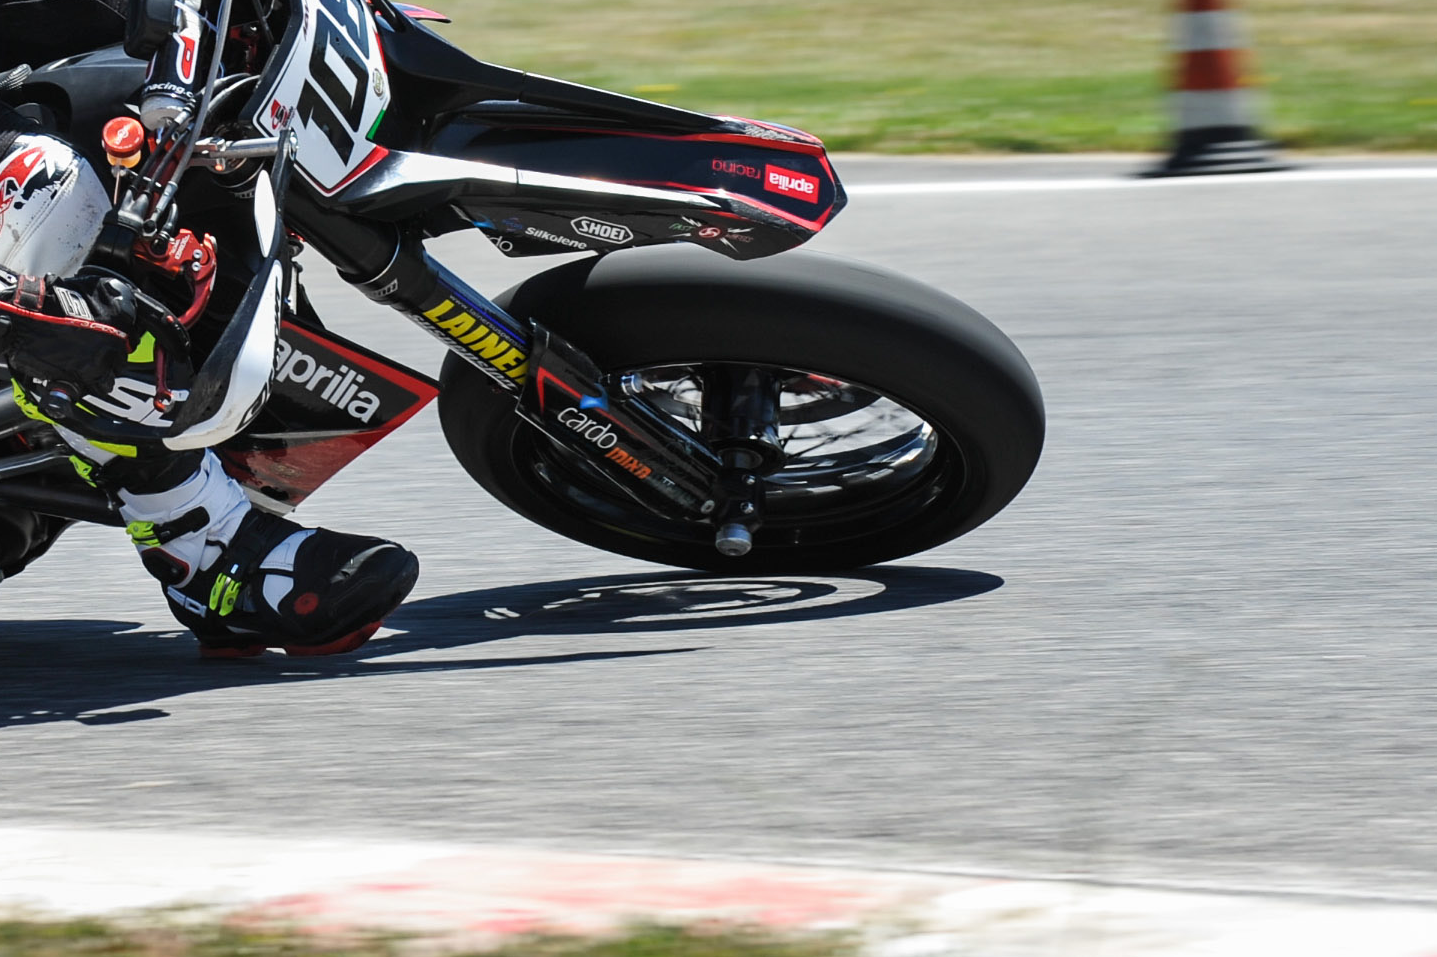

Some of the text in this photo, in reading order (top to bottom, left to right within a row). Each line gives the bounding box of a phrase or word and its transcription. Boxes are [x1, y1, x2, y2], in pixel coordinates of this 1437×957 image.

[712, 159, 815, 194] aprilia racing
[525, 226, 589, 250] Silkolene
[578, 220, 626, 241] SHOEI
[557, 407, 618, 449] cardo
